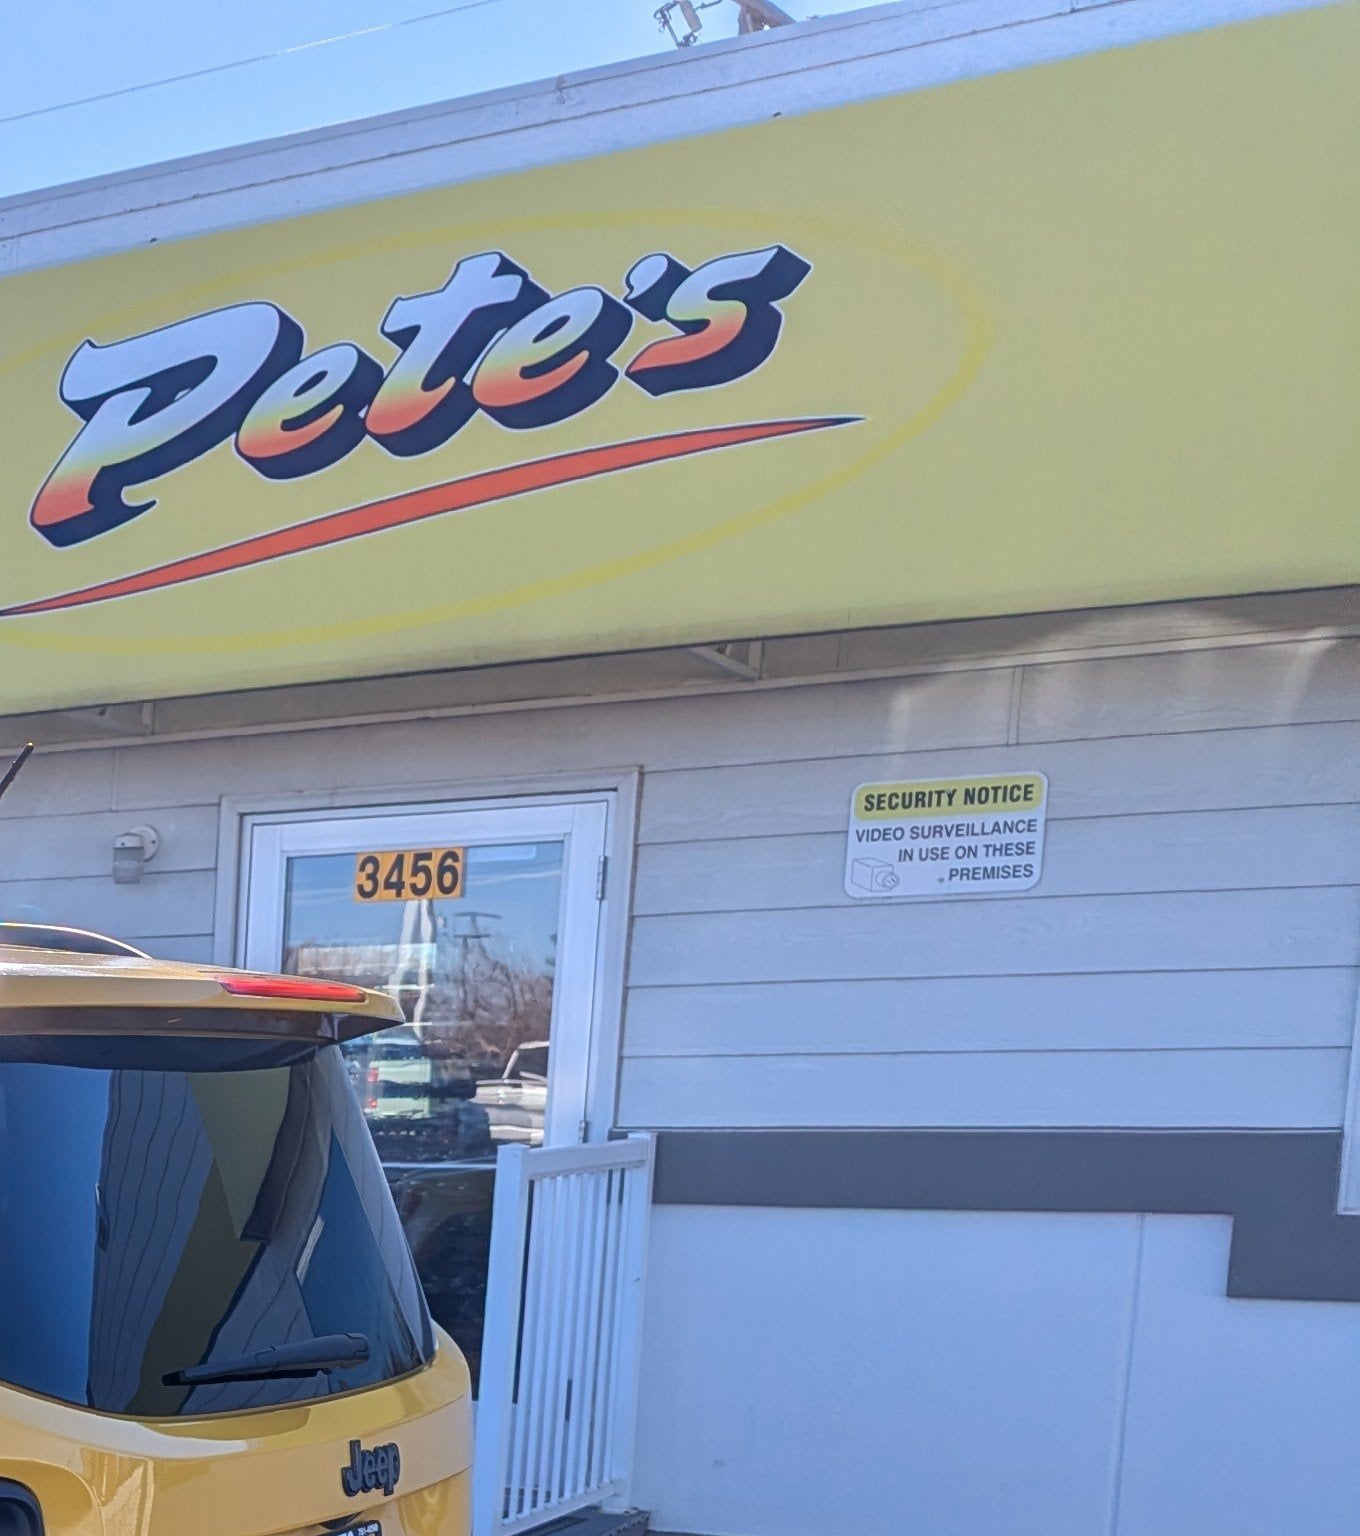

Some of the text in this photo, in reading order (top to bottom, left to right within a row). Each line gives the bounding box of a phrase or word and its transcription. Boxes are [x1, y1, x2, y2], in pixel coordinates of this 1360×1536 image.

[30, 244, 813, 547] Pete's
[863, 783, 1035, 812] SECURITY NOTICE
[855, 819, 1038, 843] VIDEO SURVEILLANCE
[898, 841, 1036, 862] IN USE ON THESE
[357, 850, 460, 899] 3456
[948, 863, 1034, 881] PREMISES
[341, 1439, 401, 1497] Jeep
